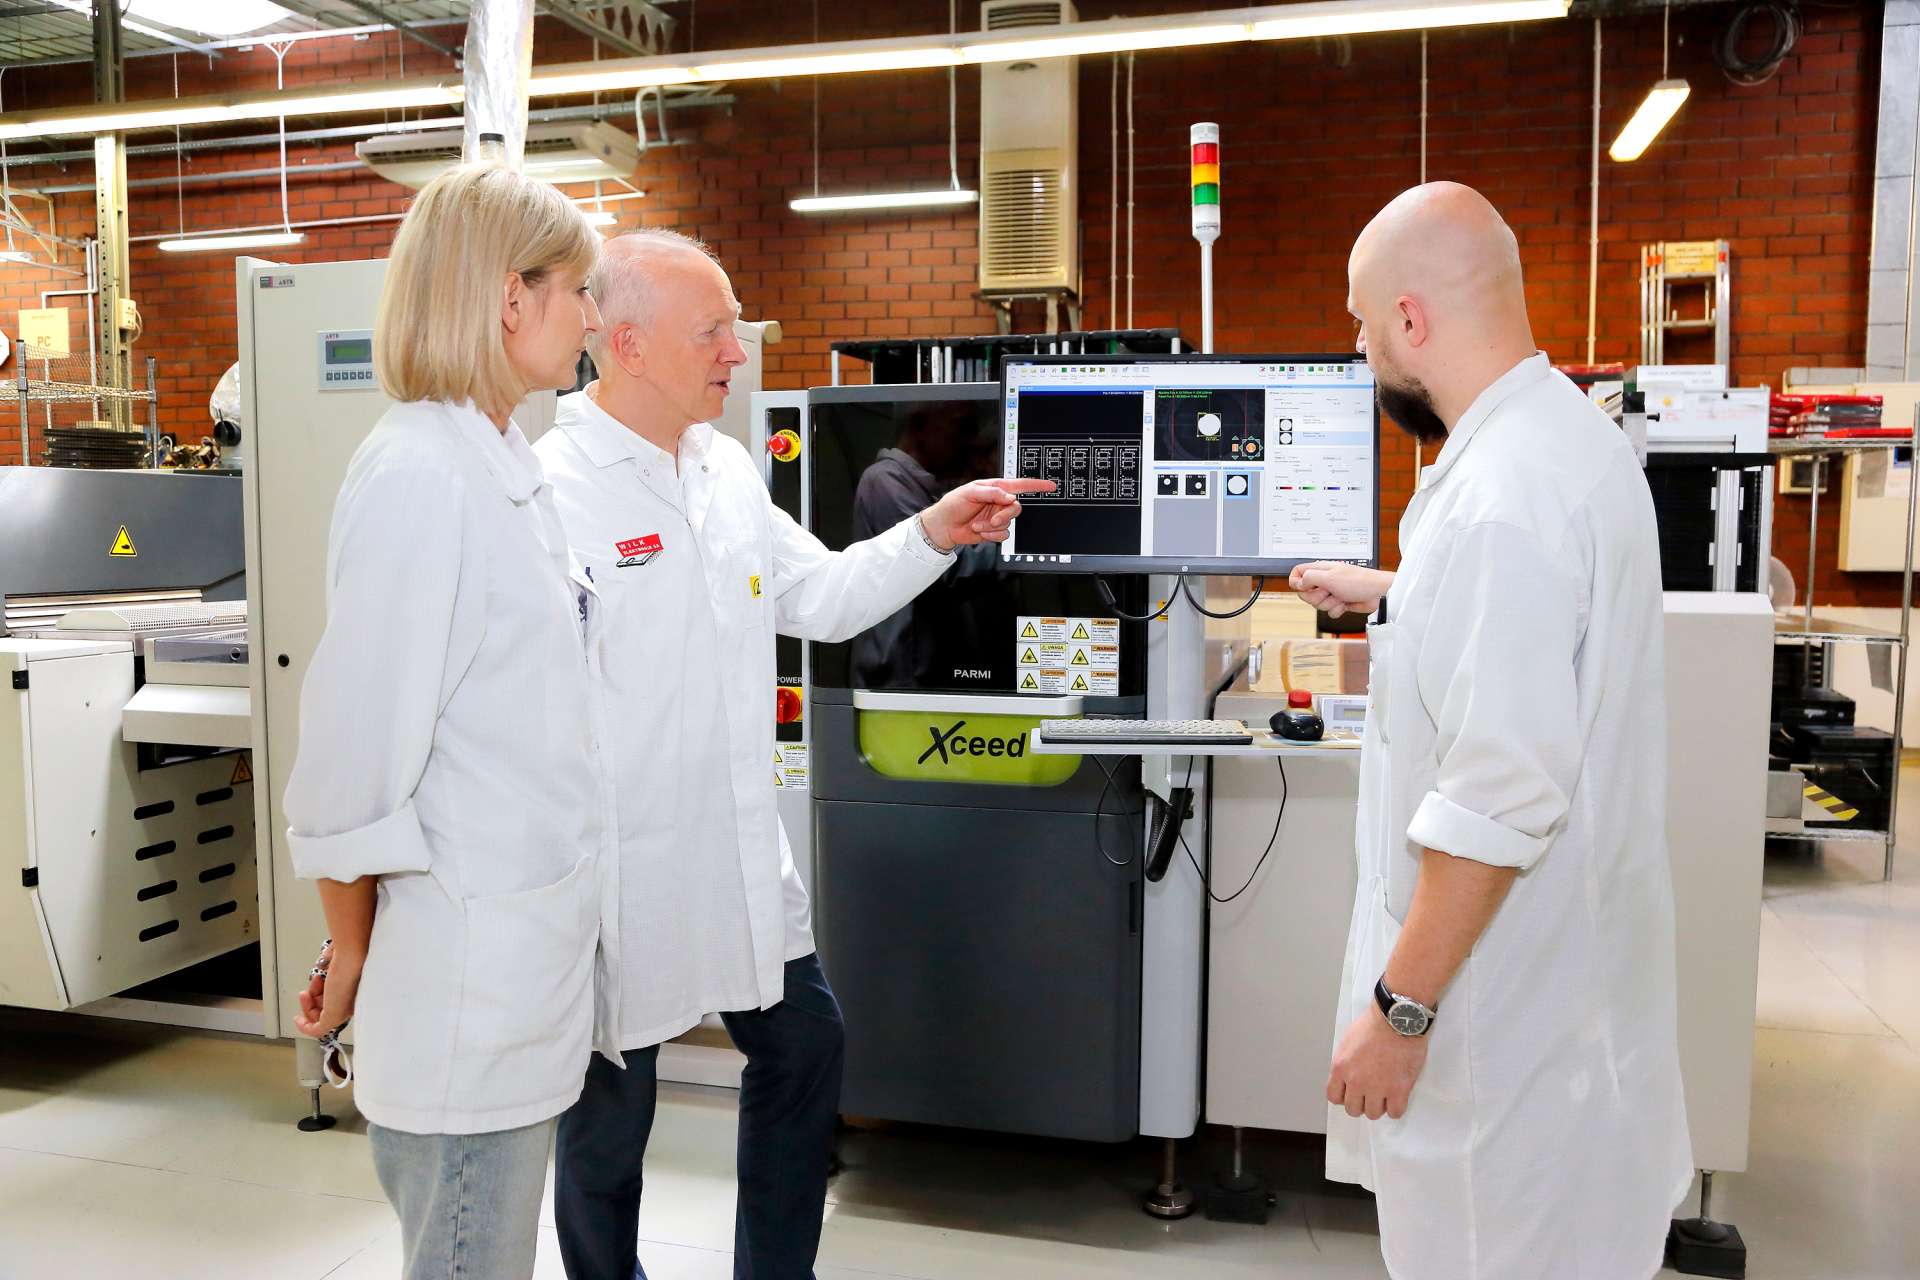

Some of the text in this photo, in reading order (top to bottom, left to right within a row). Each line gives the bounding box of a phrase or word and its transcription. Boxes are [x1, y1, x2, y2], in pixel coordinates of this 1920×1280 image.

[37, 335, 51, 347] PC
[618, 539, 646, 550] WILK
[953, 669, 992, 679] PARMI
[918, 720, 1027, 765] Xceed
